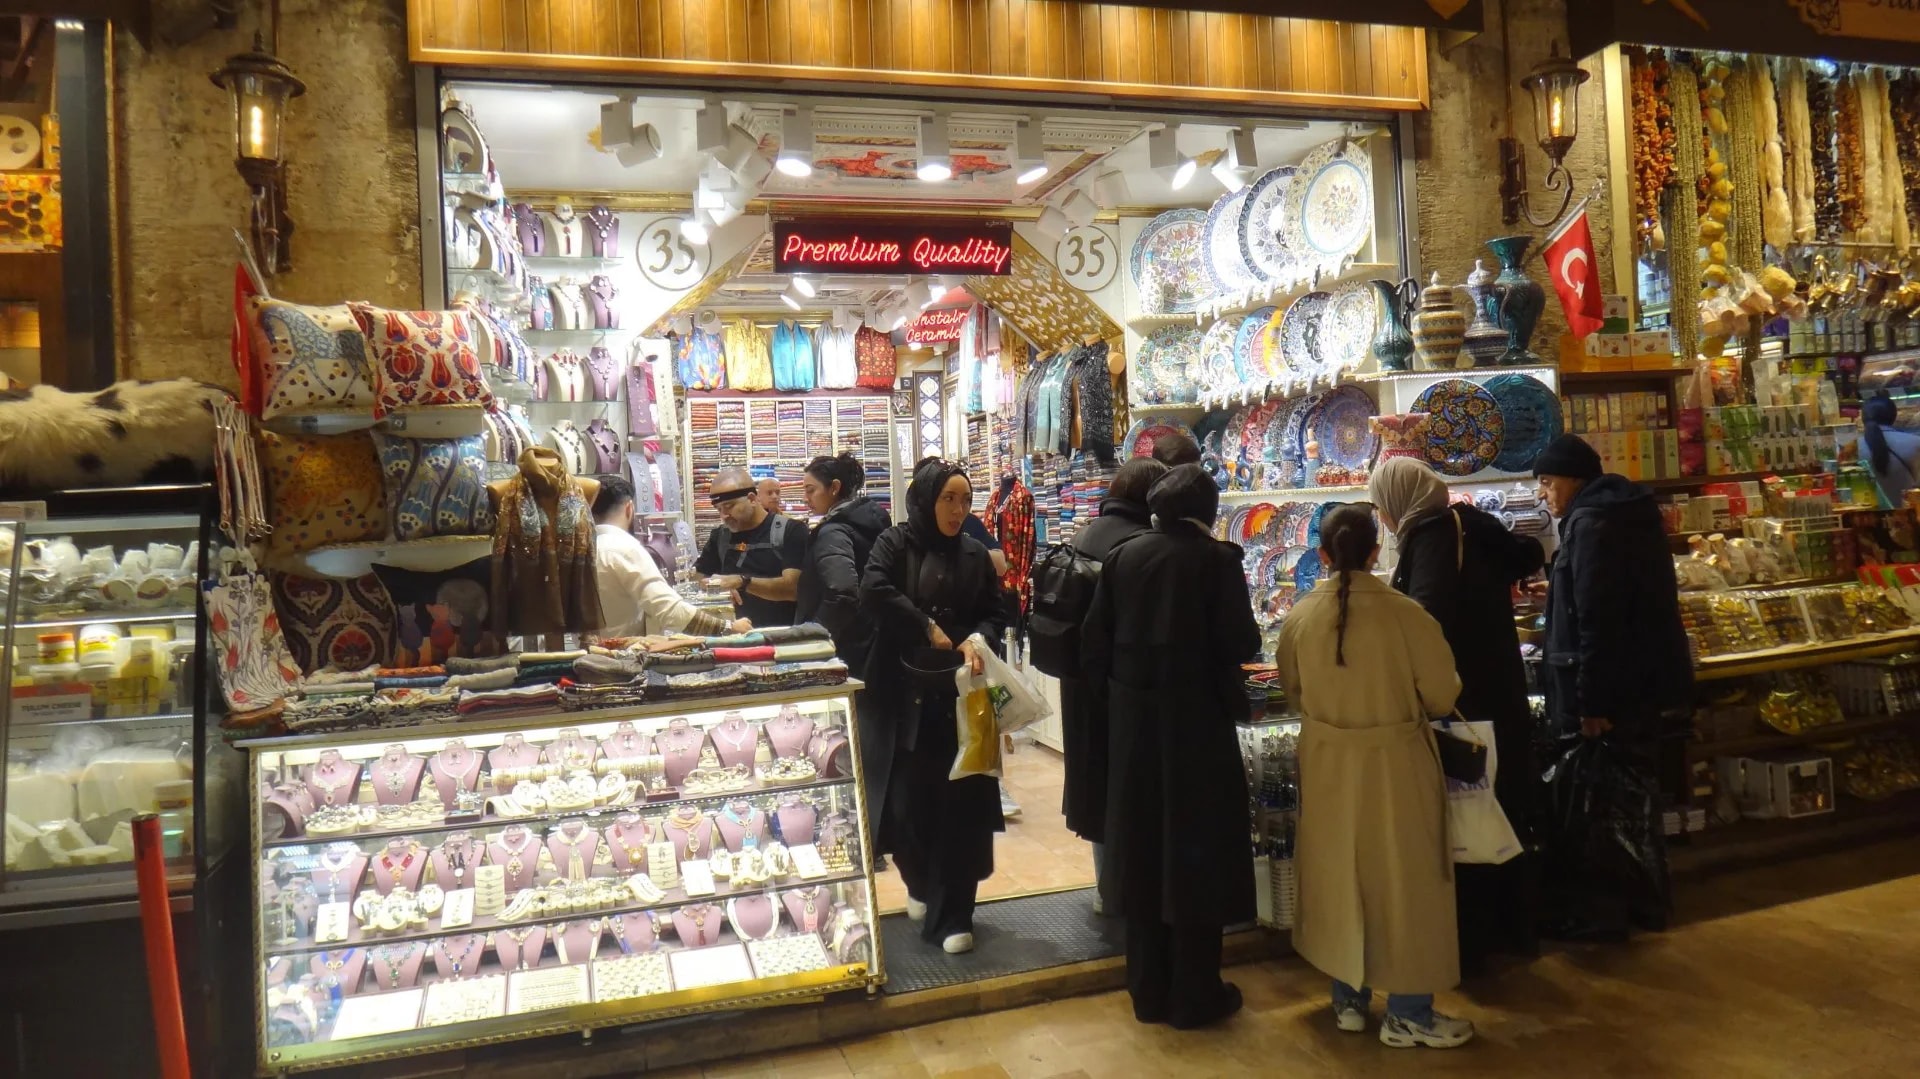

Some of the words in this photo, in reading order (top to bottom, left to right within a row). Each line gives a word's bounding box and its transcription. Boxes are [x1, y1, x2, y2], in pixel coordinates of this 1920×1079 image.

[649, 229, 696, 275] 35
[782, 234, 901, 263] Premium
[912, 237, 1011, 273] Quality
[1065, 235, 1105, 278] 35
